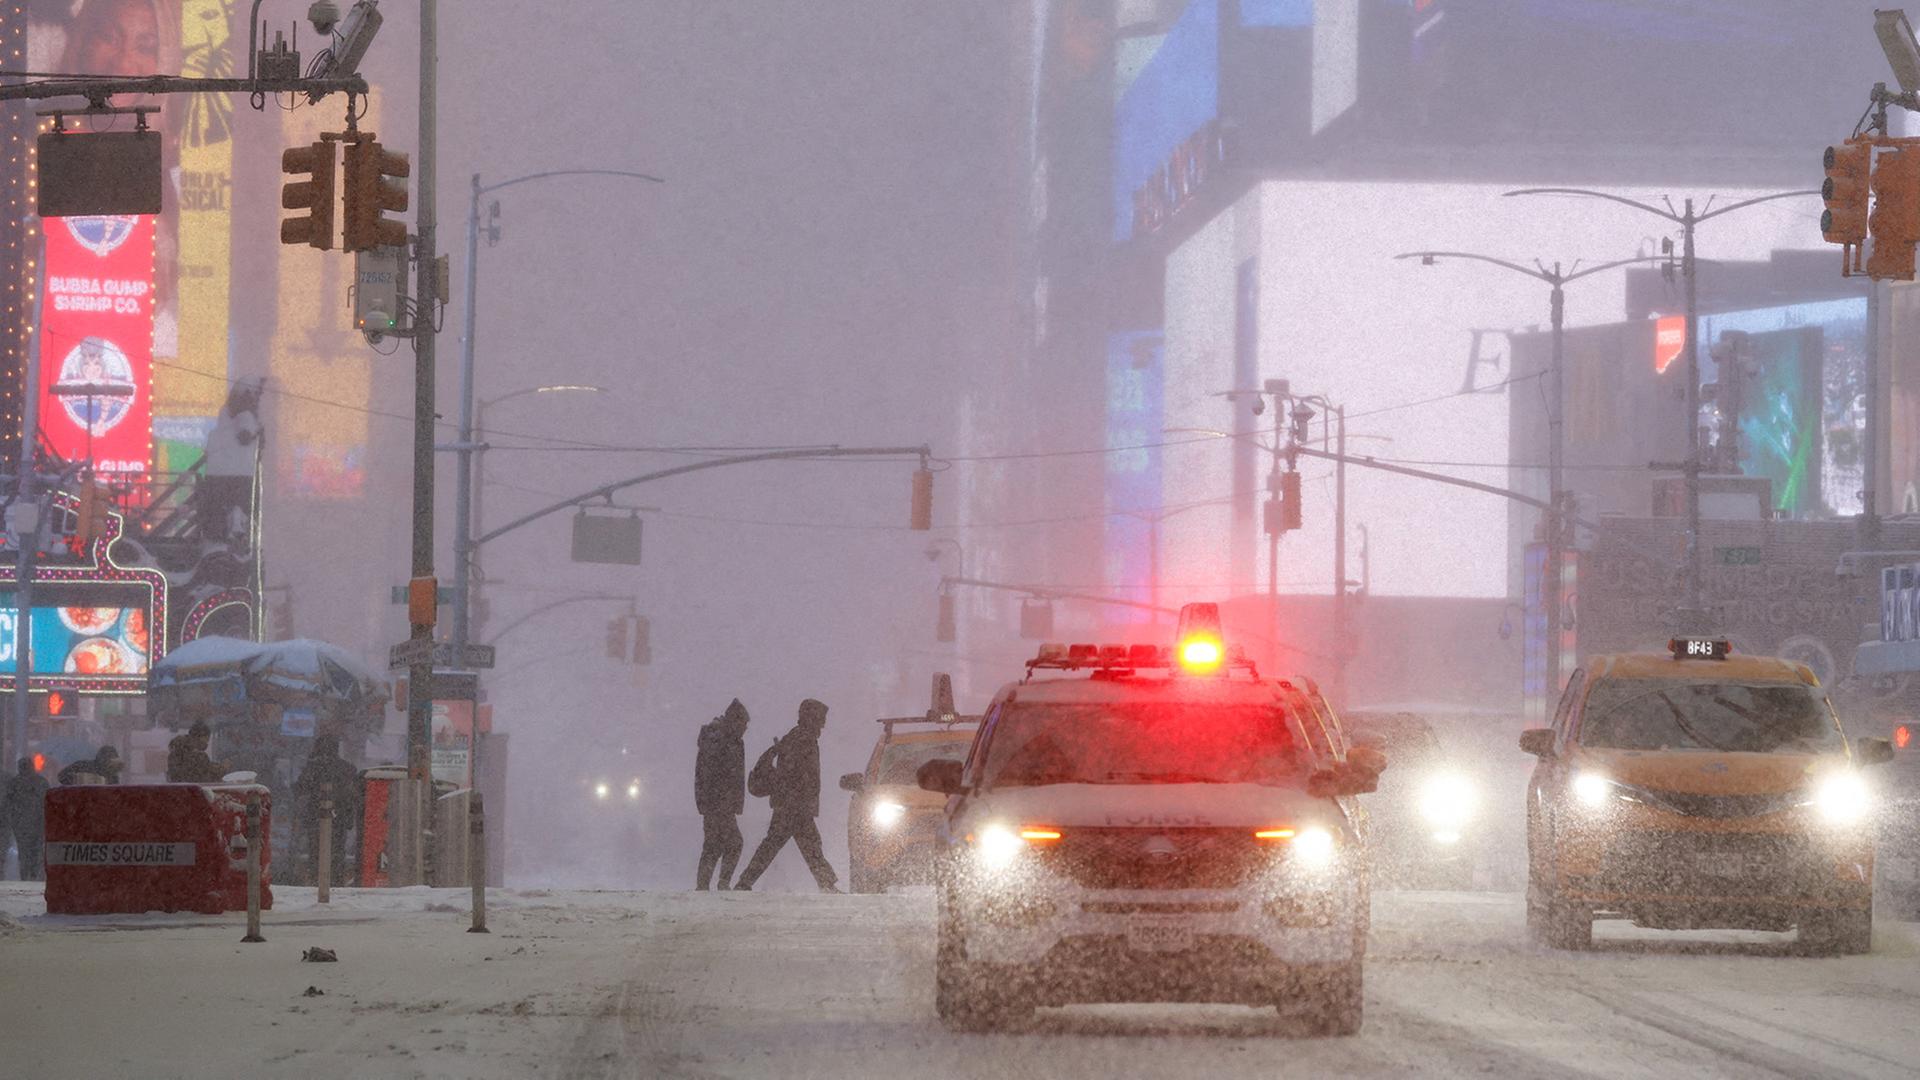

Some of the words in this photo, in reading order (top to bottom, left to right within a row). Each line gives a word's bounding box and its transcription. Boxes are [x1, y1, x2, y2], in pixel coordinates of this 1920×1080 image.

[49, 276, 101, 294] BUBBA
[103, 279, 148, 296] GUMP
[54, 295, 112, 312] SHRIMP
[115, 297, 141, 314] CO.
[62, 845, 108, 862] TIMES
[112, 845, 175, 862] SQUARE
